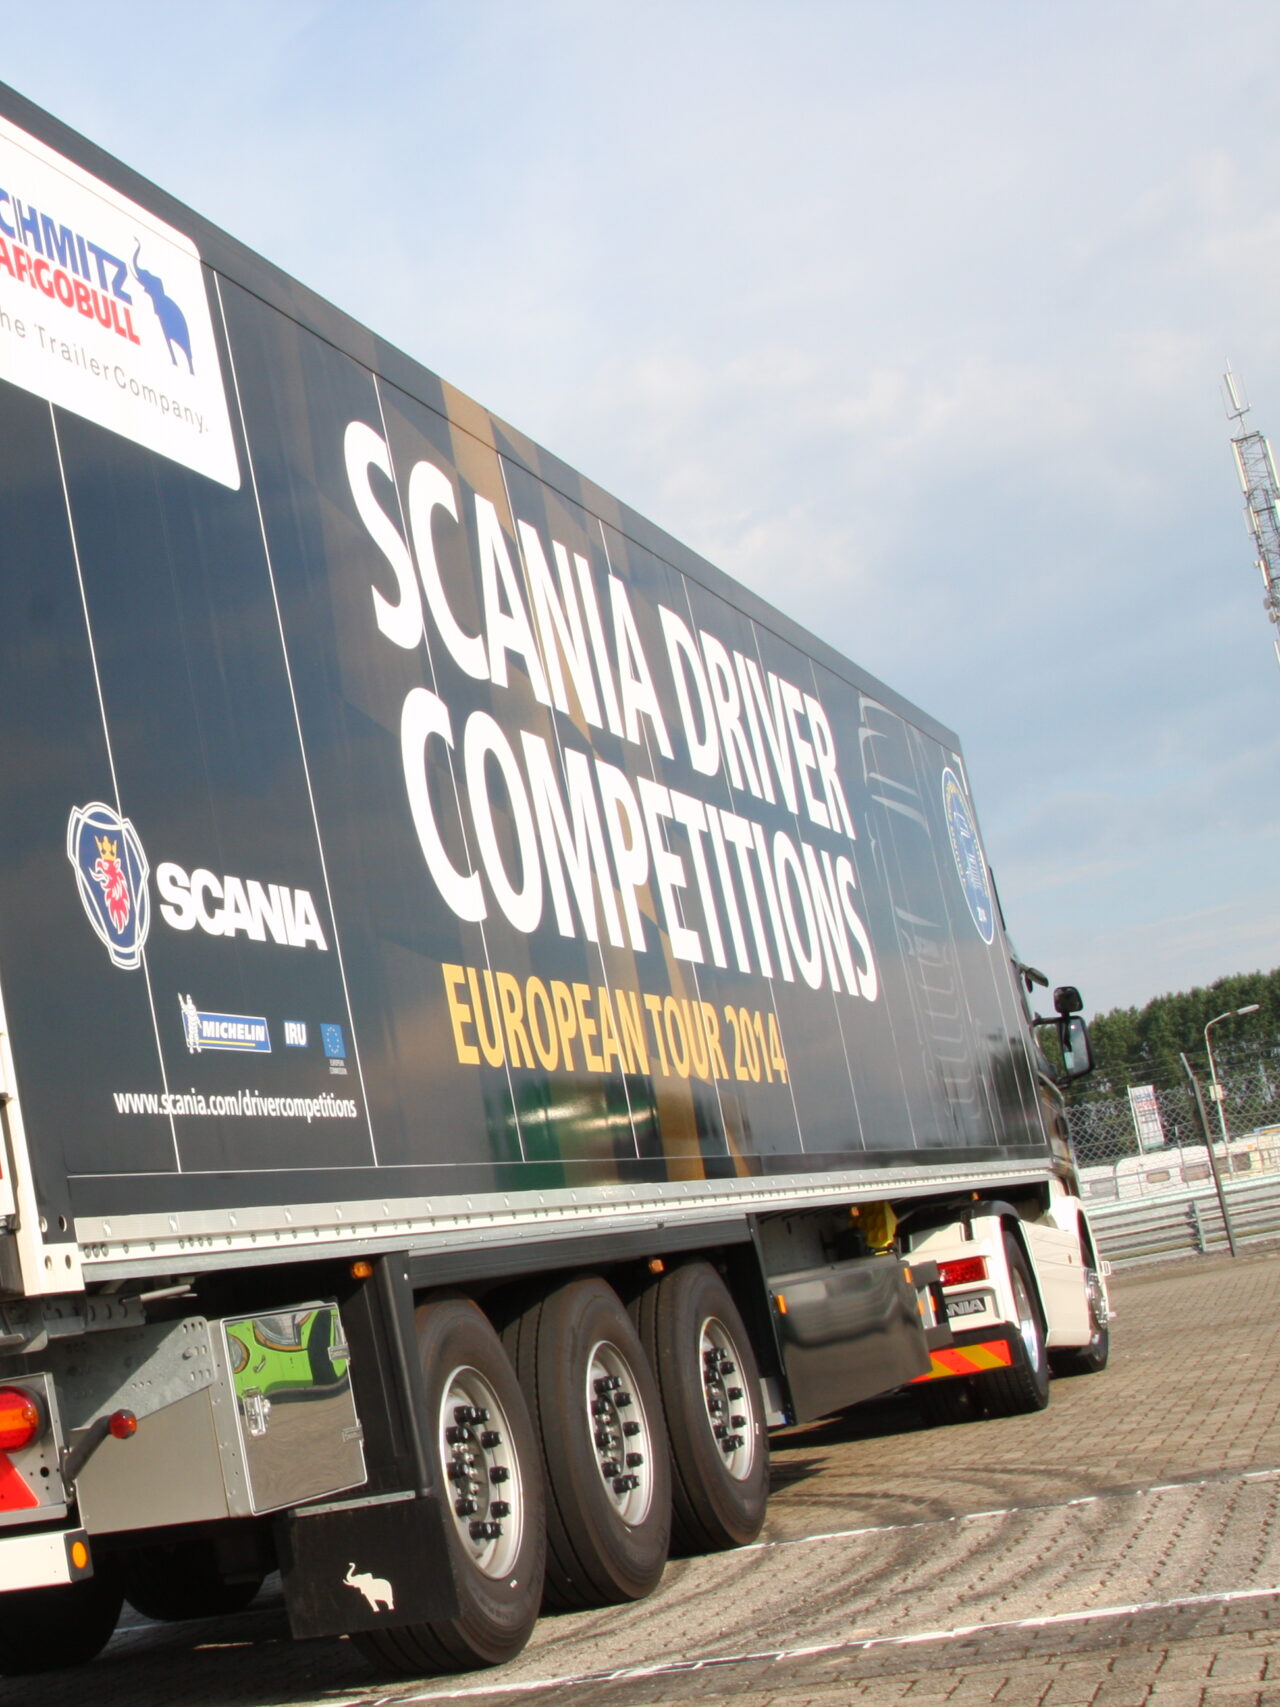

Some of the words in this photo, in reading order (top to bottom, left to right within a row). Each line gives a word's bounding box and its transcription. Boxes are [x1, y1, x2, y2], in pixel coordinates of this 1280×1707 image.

[344, 421, 674, 760] SCANIA
[657, 604, 855, 840] DRIVER
[400, 687, 877, 1002] COMPETITIONS
[156, 862, 328, 950] SCANIA
[203, 1021, 265, 1042] MICHELIN
[285, 1022, 306, 1045] IRU
[441, 962, 649, 1075] EUROPEAN
[645, 993, 724, 1081] TOUR
[729, 1003, 787, 1084] 2014
[114, 1088, 357, 1123] www.scania.com/drivercompetitions
